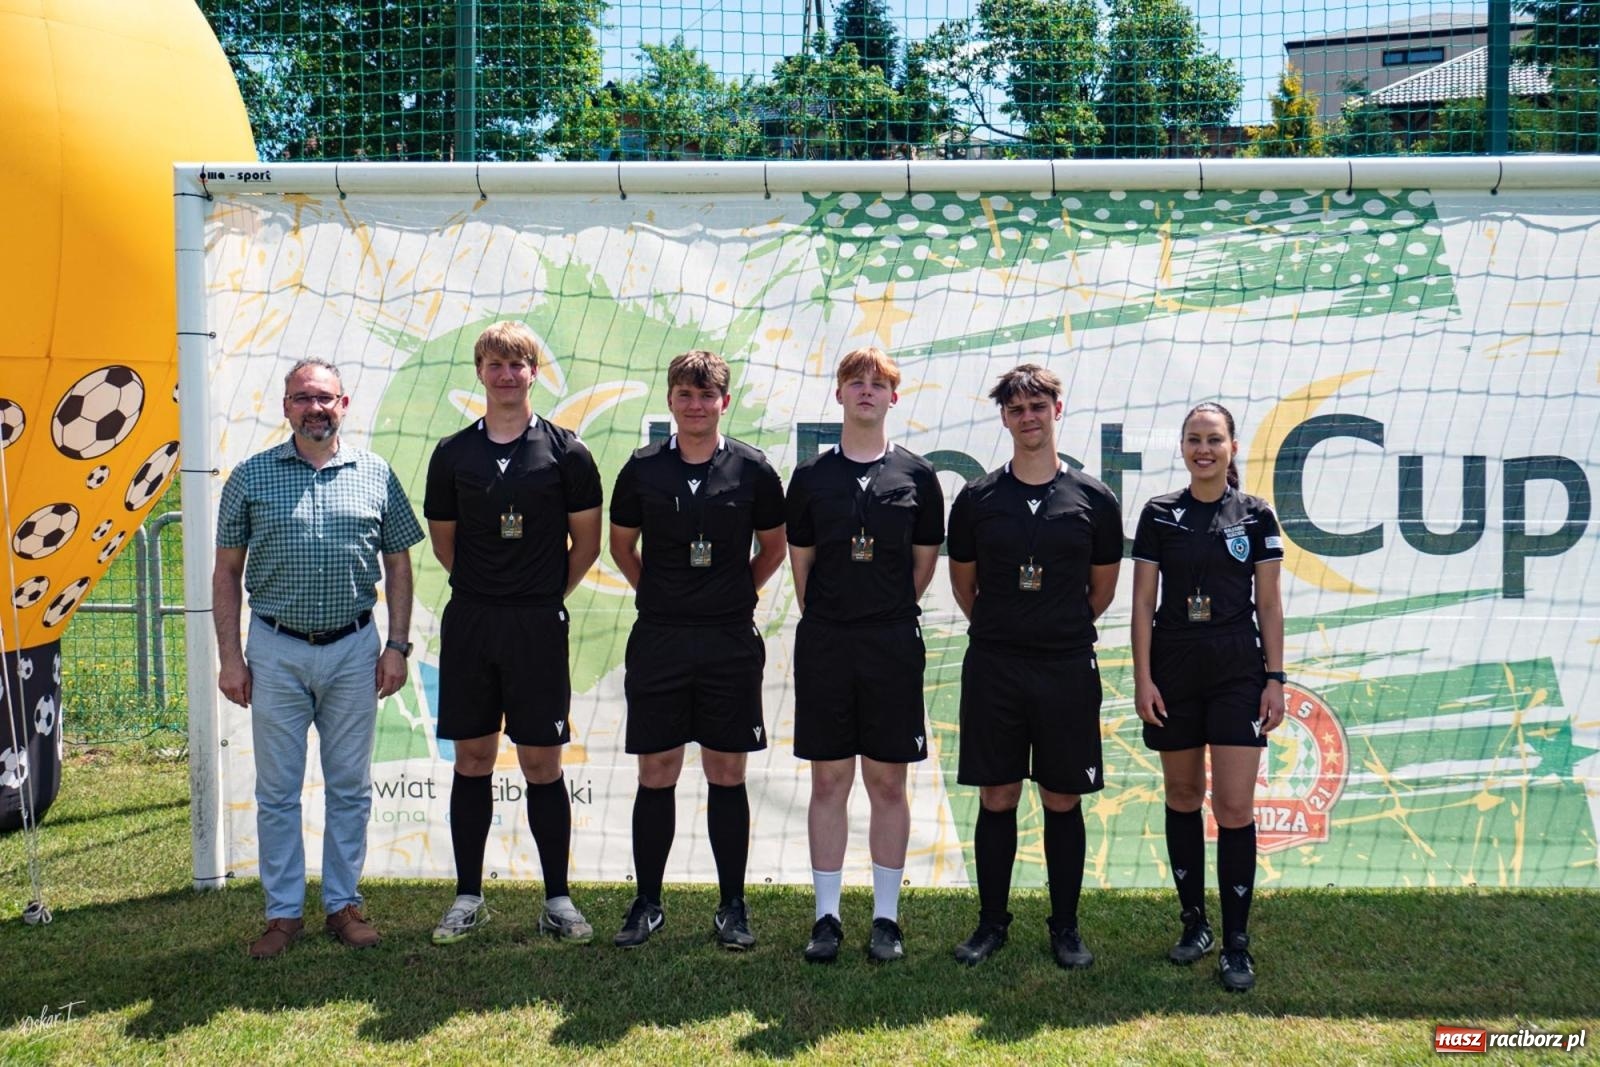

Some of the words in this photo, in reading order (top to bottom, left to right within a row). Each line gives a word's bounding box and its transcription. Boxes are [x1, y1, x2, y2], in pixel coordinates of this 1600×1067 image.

[237, 170, 271, 183] sport
[1273, 413, 1592, 599] Cup
[373, 773, 437, 799] wiat
[1309, 787, 1333, 810] 21
